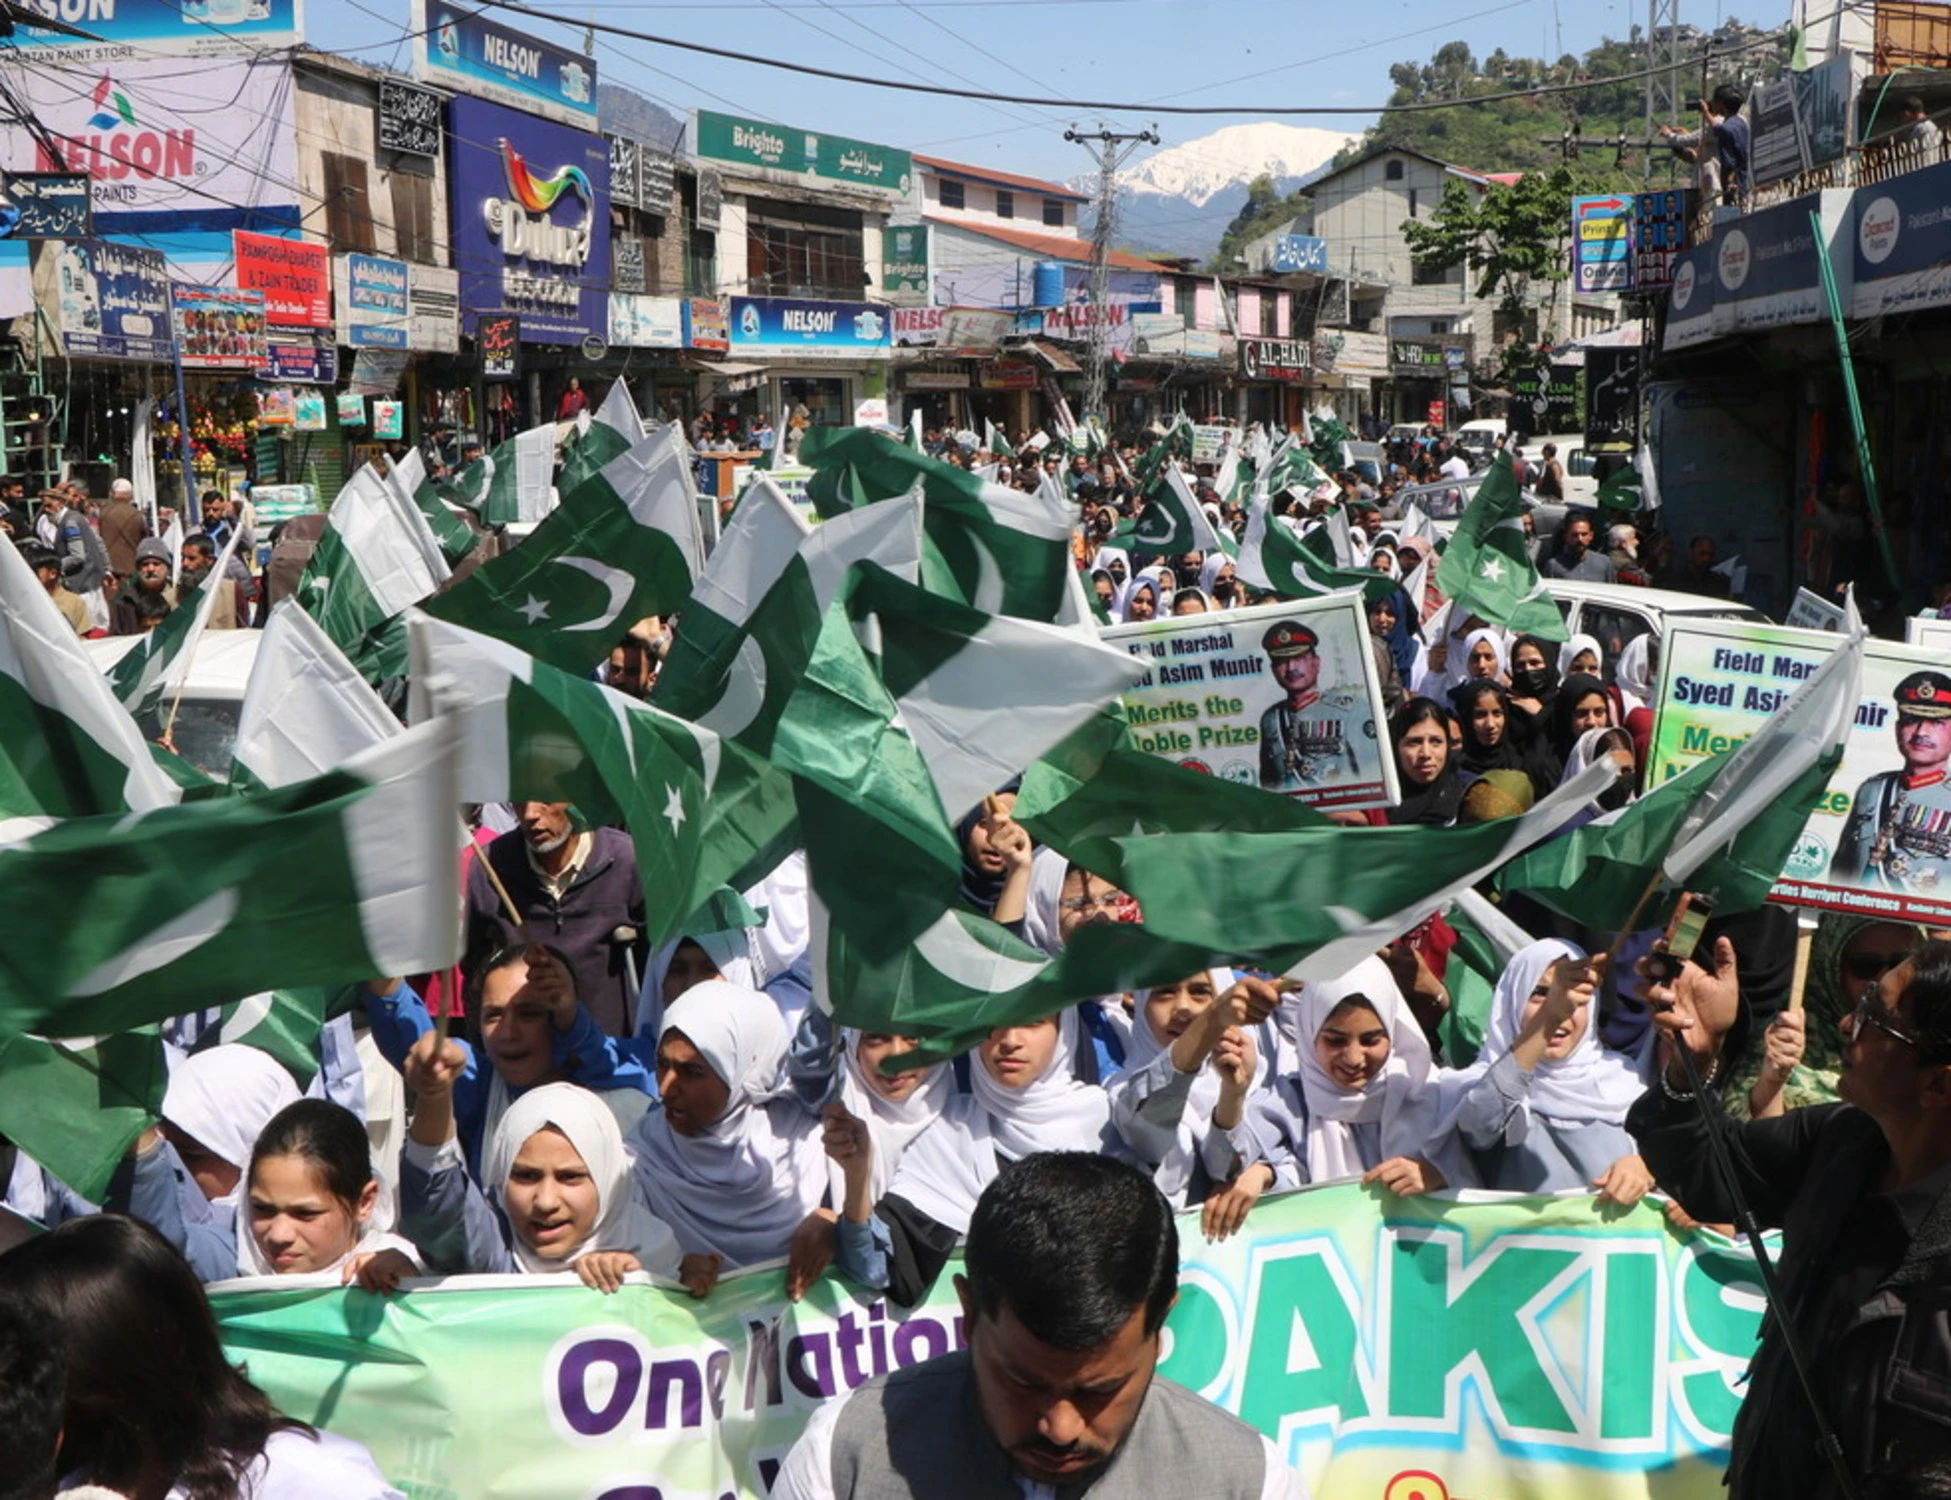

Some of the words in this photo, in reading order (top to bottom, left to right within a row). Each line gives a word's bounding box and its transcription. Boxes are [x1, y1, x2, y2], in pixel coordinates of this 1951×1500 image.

[57, 49, 91, 60] PAINT
[95, 46, 135, 58] STORE
[484, 33, 540, 78] NELSON
[733, 126, 784, 155] Brighto
[35, 129, 195, 181] NELSON
[93, 185, 137, 201] PAINTS
[502, 200, 584, 268] Dulux
[885, 263, 926, 279] Brighto
[1583, 265, 1626, 280] Online
[784, 309, 834, 333] NELSON
[894, 309, 947, 331] NELS
[1047, 303, 1126, 328] NELSN
[1259, 342, 1311, 368] AL-HADI
[1171, 633, 1233, 656] Marshal
[1160, 663, 1204, 685] Asim
[1209, 655, 1263, 679] Munir
[1714, 648, 1764, 674] Field
[1127, 700, 1199, 724] Merits
[1205, 695, 1243, 714] the
[1674, 676, 1735, 708] Syed
[1743, 686, 1790, 712] Asi
[1854, 702, 1889, 728] nir
[1198, 725, 1258, 747] Prize
[558, 1338, 730, 1435] One
[744, 1299, 967, 1411] Natio
